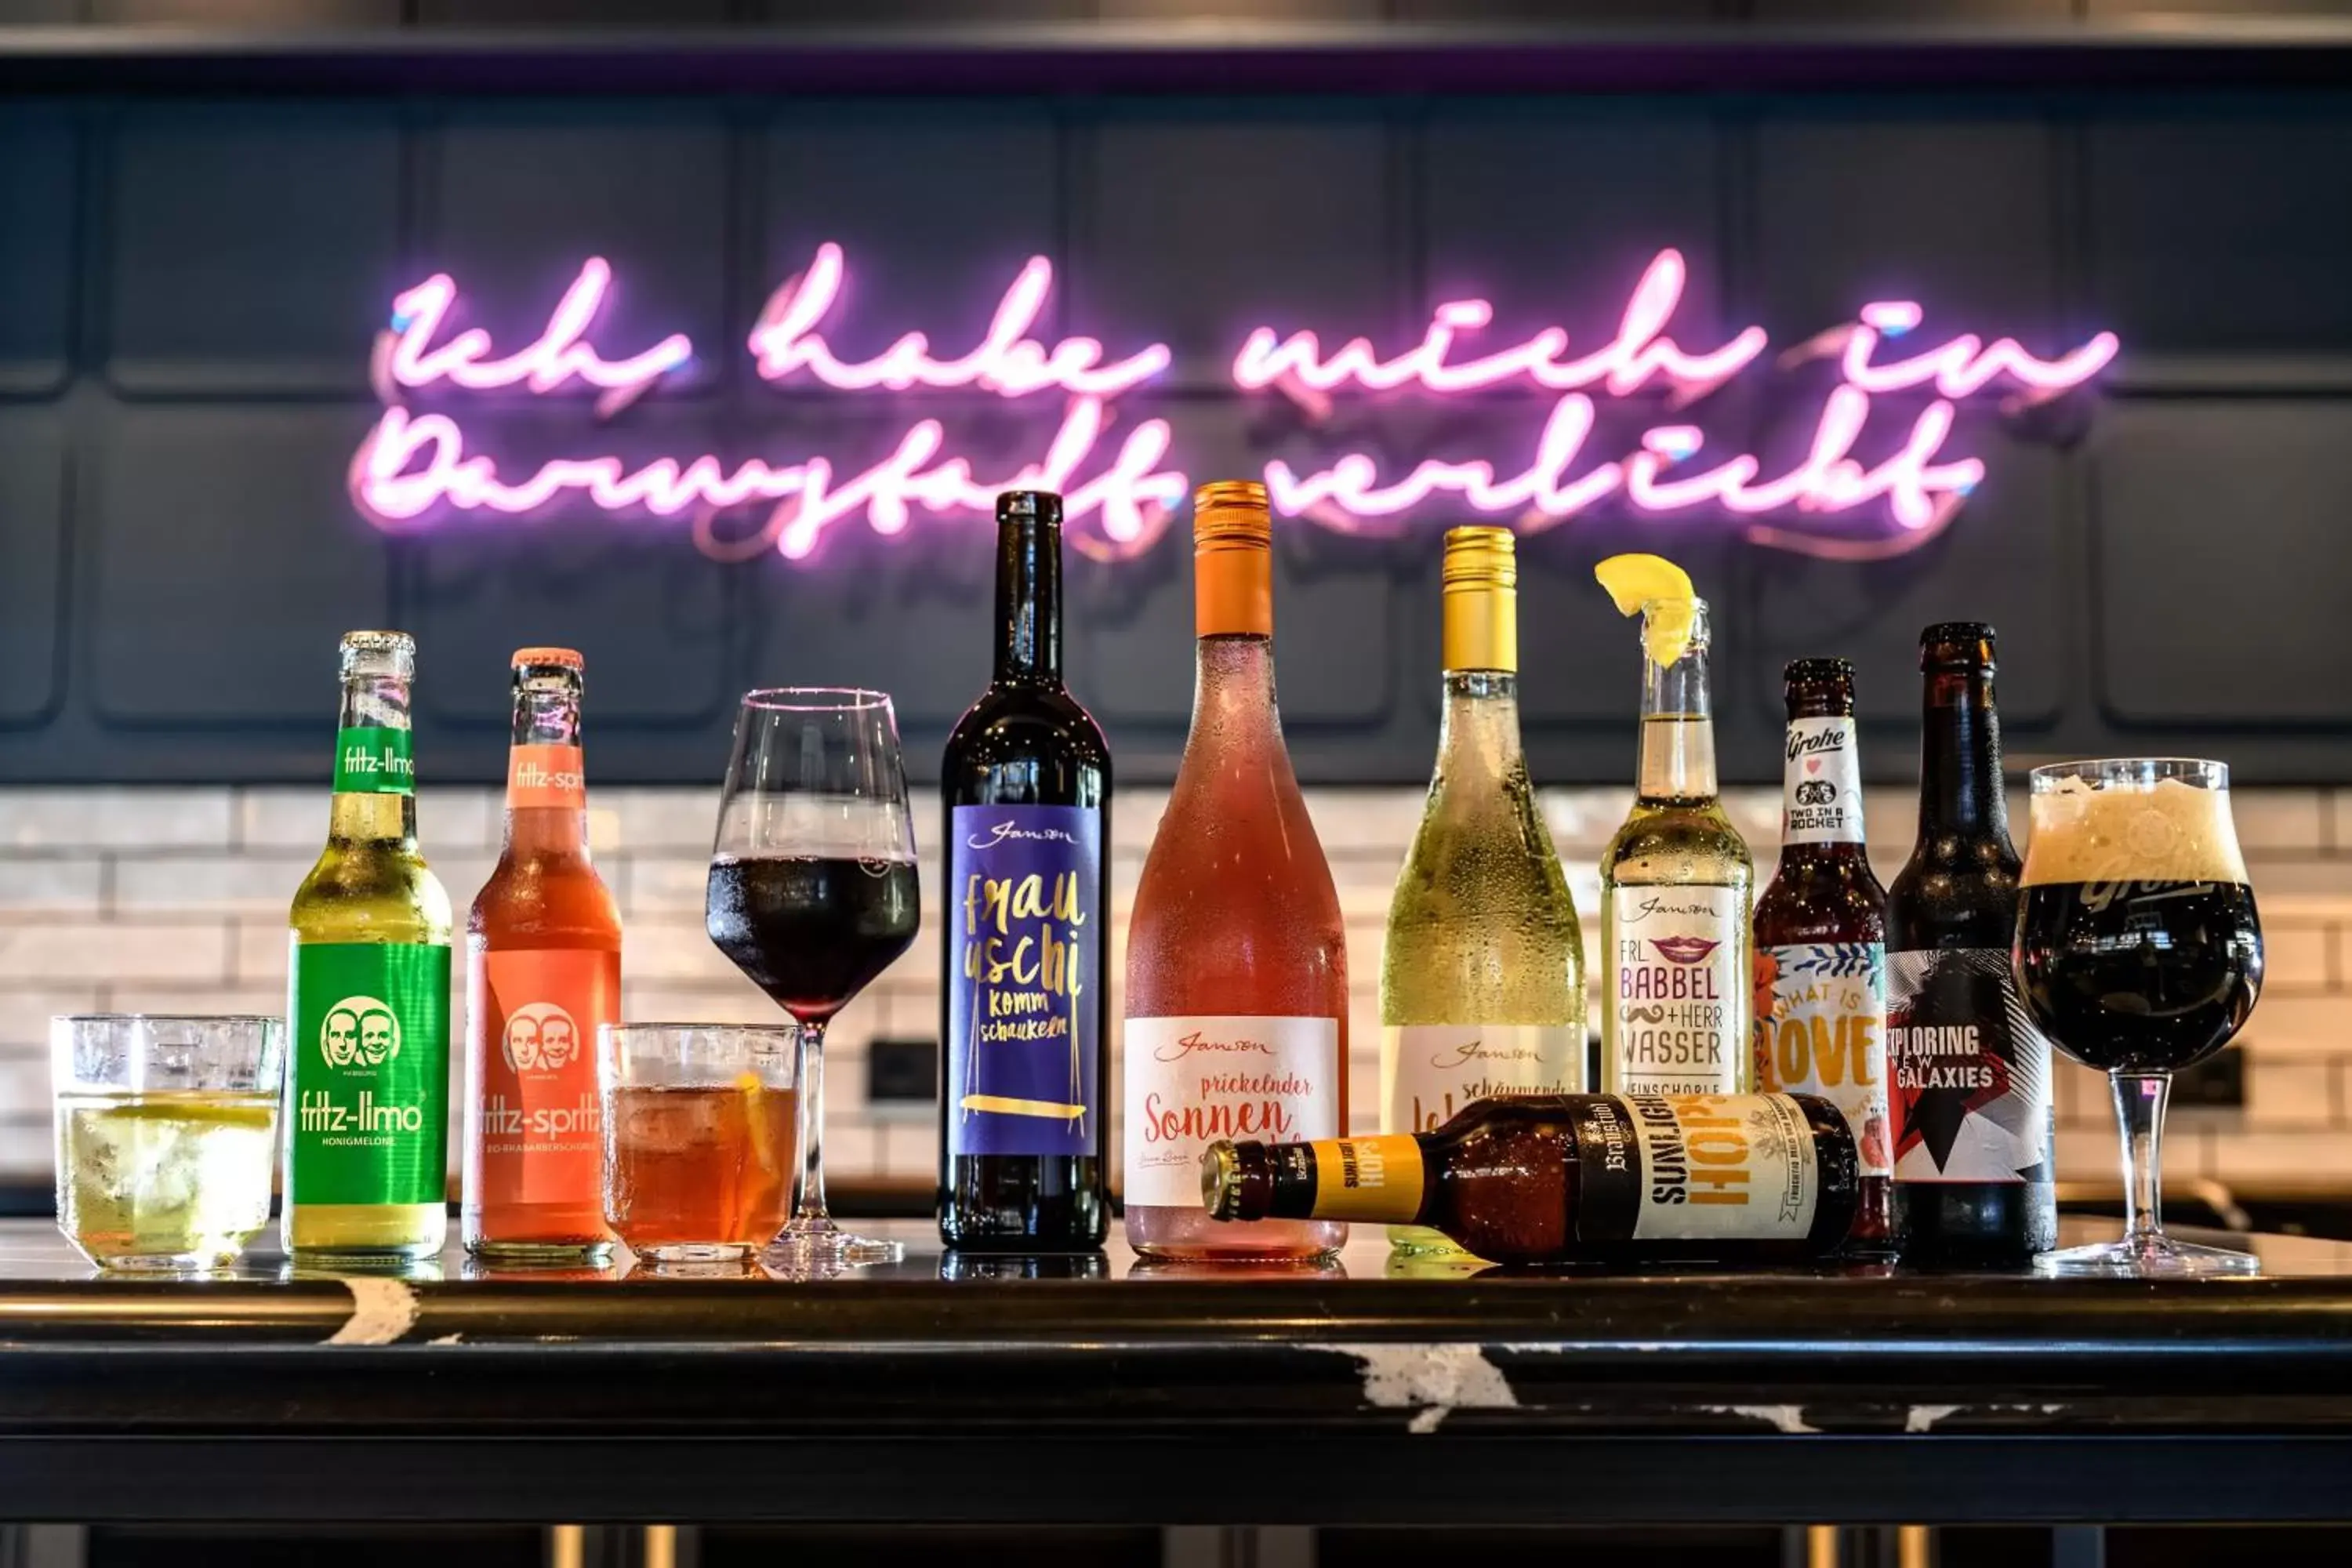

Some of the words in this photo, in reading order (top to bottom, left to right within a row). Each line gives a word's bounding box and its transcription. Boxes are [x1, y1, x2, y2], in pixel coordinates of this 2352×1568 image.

[391, 256, 691, 394] Ich
[748, 241, 1171, 398] habe
[1234, 249, 1768, 396] mich
[1844, 299, 2120, 398] in
[359, 398, 1188, 558] Darmstadt
[1264, 383, 1986, 529] verliebt
[345, 745, 415, 775] fritz-limo
[1787, 728, 1845, 762] Grohe
[1791, 808, 1813, 819] TWO
[1817, 807, 1832, 816] IN
[1835, 807, 1843, 816] A
[1791, 817, 1844, 830] ROCKET
[964, 869, 1086, 935] frau
[1620, 967, 1720, 1000] BABBEL
[989, 989, 1049, 1018] komm
[1773, 984, 1832, 1019] WHAT
[1839, 988, 1862, 1011] IS
[980, 1015, 1068, 1043] schaukeln
[1888, 1025, 1980, 1056] XPLORING
[1620, 1029, 1722, 1065] WASSER
[1761, 1014, 1878, 1094] LOVE
[1200, 1072, 1313, 1101] prickelnder
[1896, 1065, 1994, 1089] GALAXIES
[301, 1090, 423, 1132] fritz-limo
[1145, 1092, 1292, 1144] Sonnen
[322, 1137, 396, 1147] HONIGMELONE
